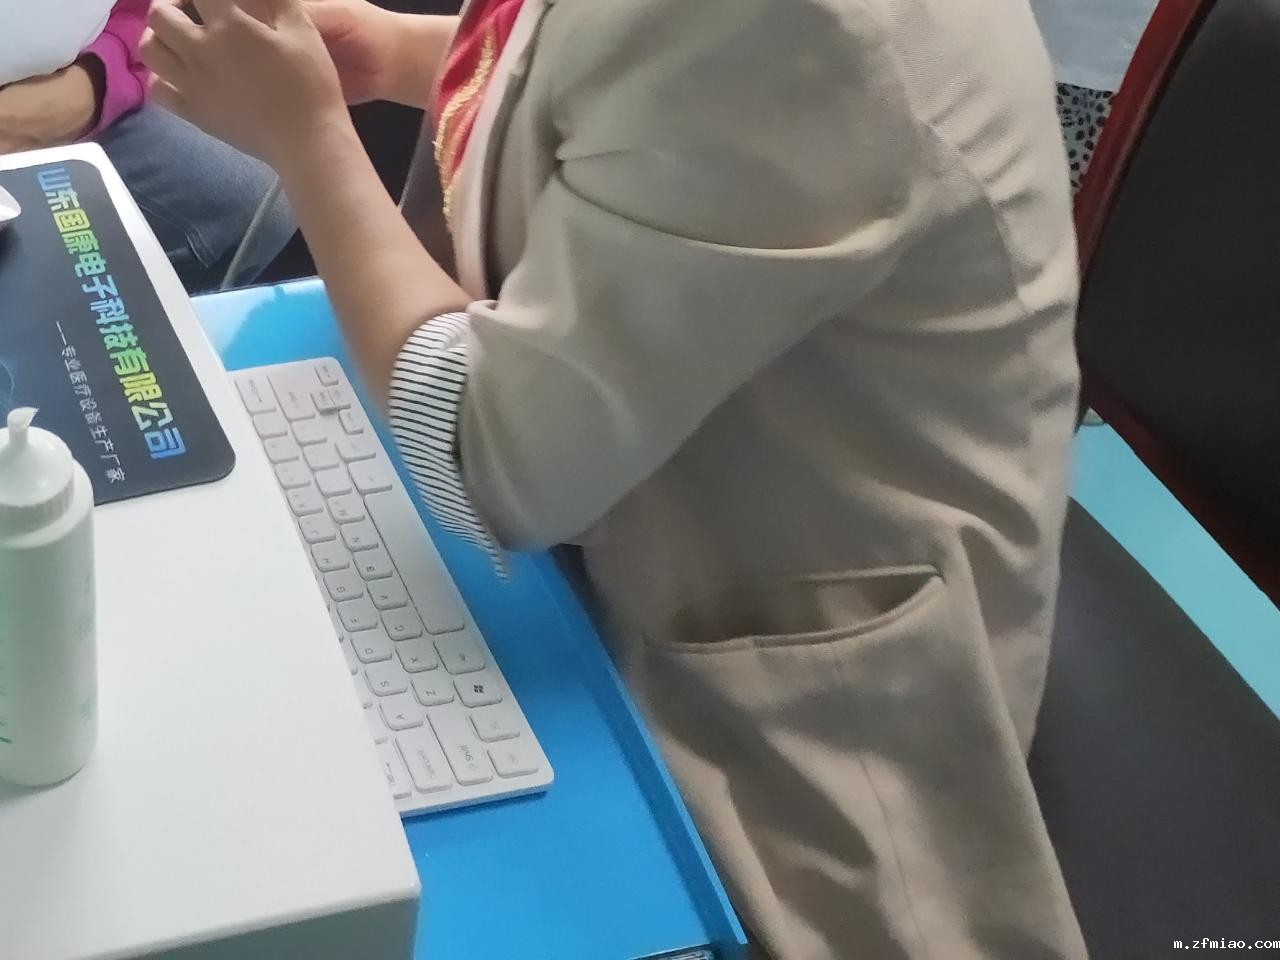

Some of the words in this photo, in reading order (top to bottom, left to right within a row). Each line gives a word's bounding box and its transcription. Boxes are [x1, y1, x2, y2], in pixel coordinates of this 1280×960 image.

[37, 167, 187, 459] 山东国康电子科技有限公司
